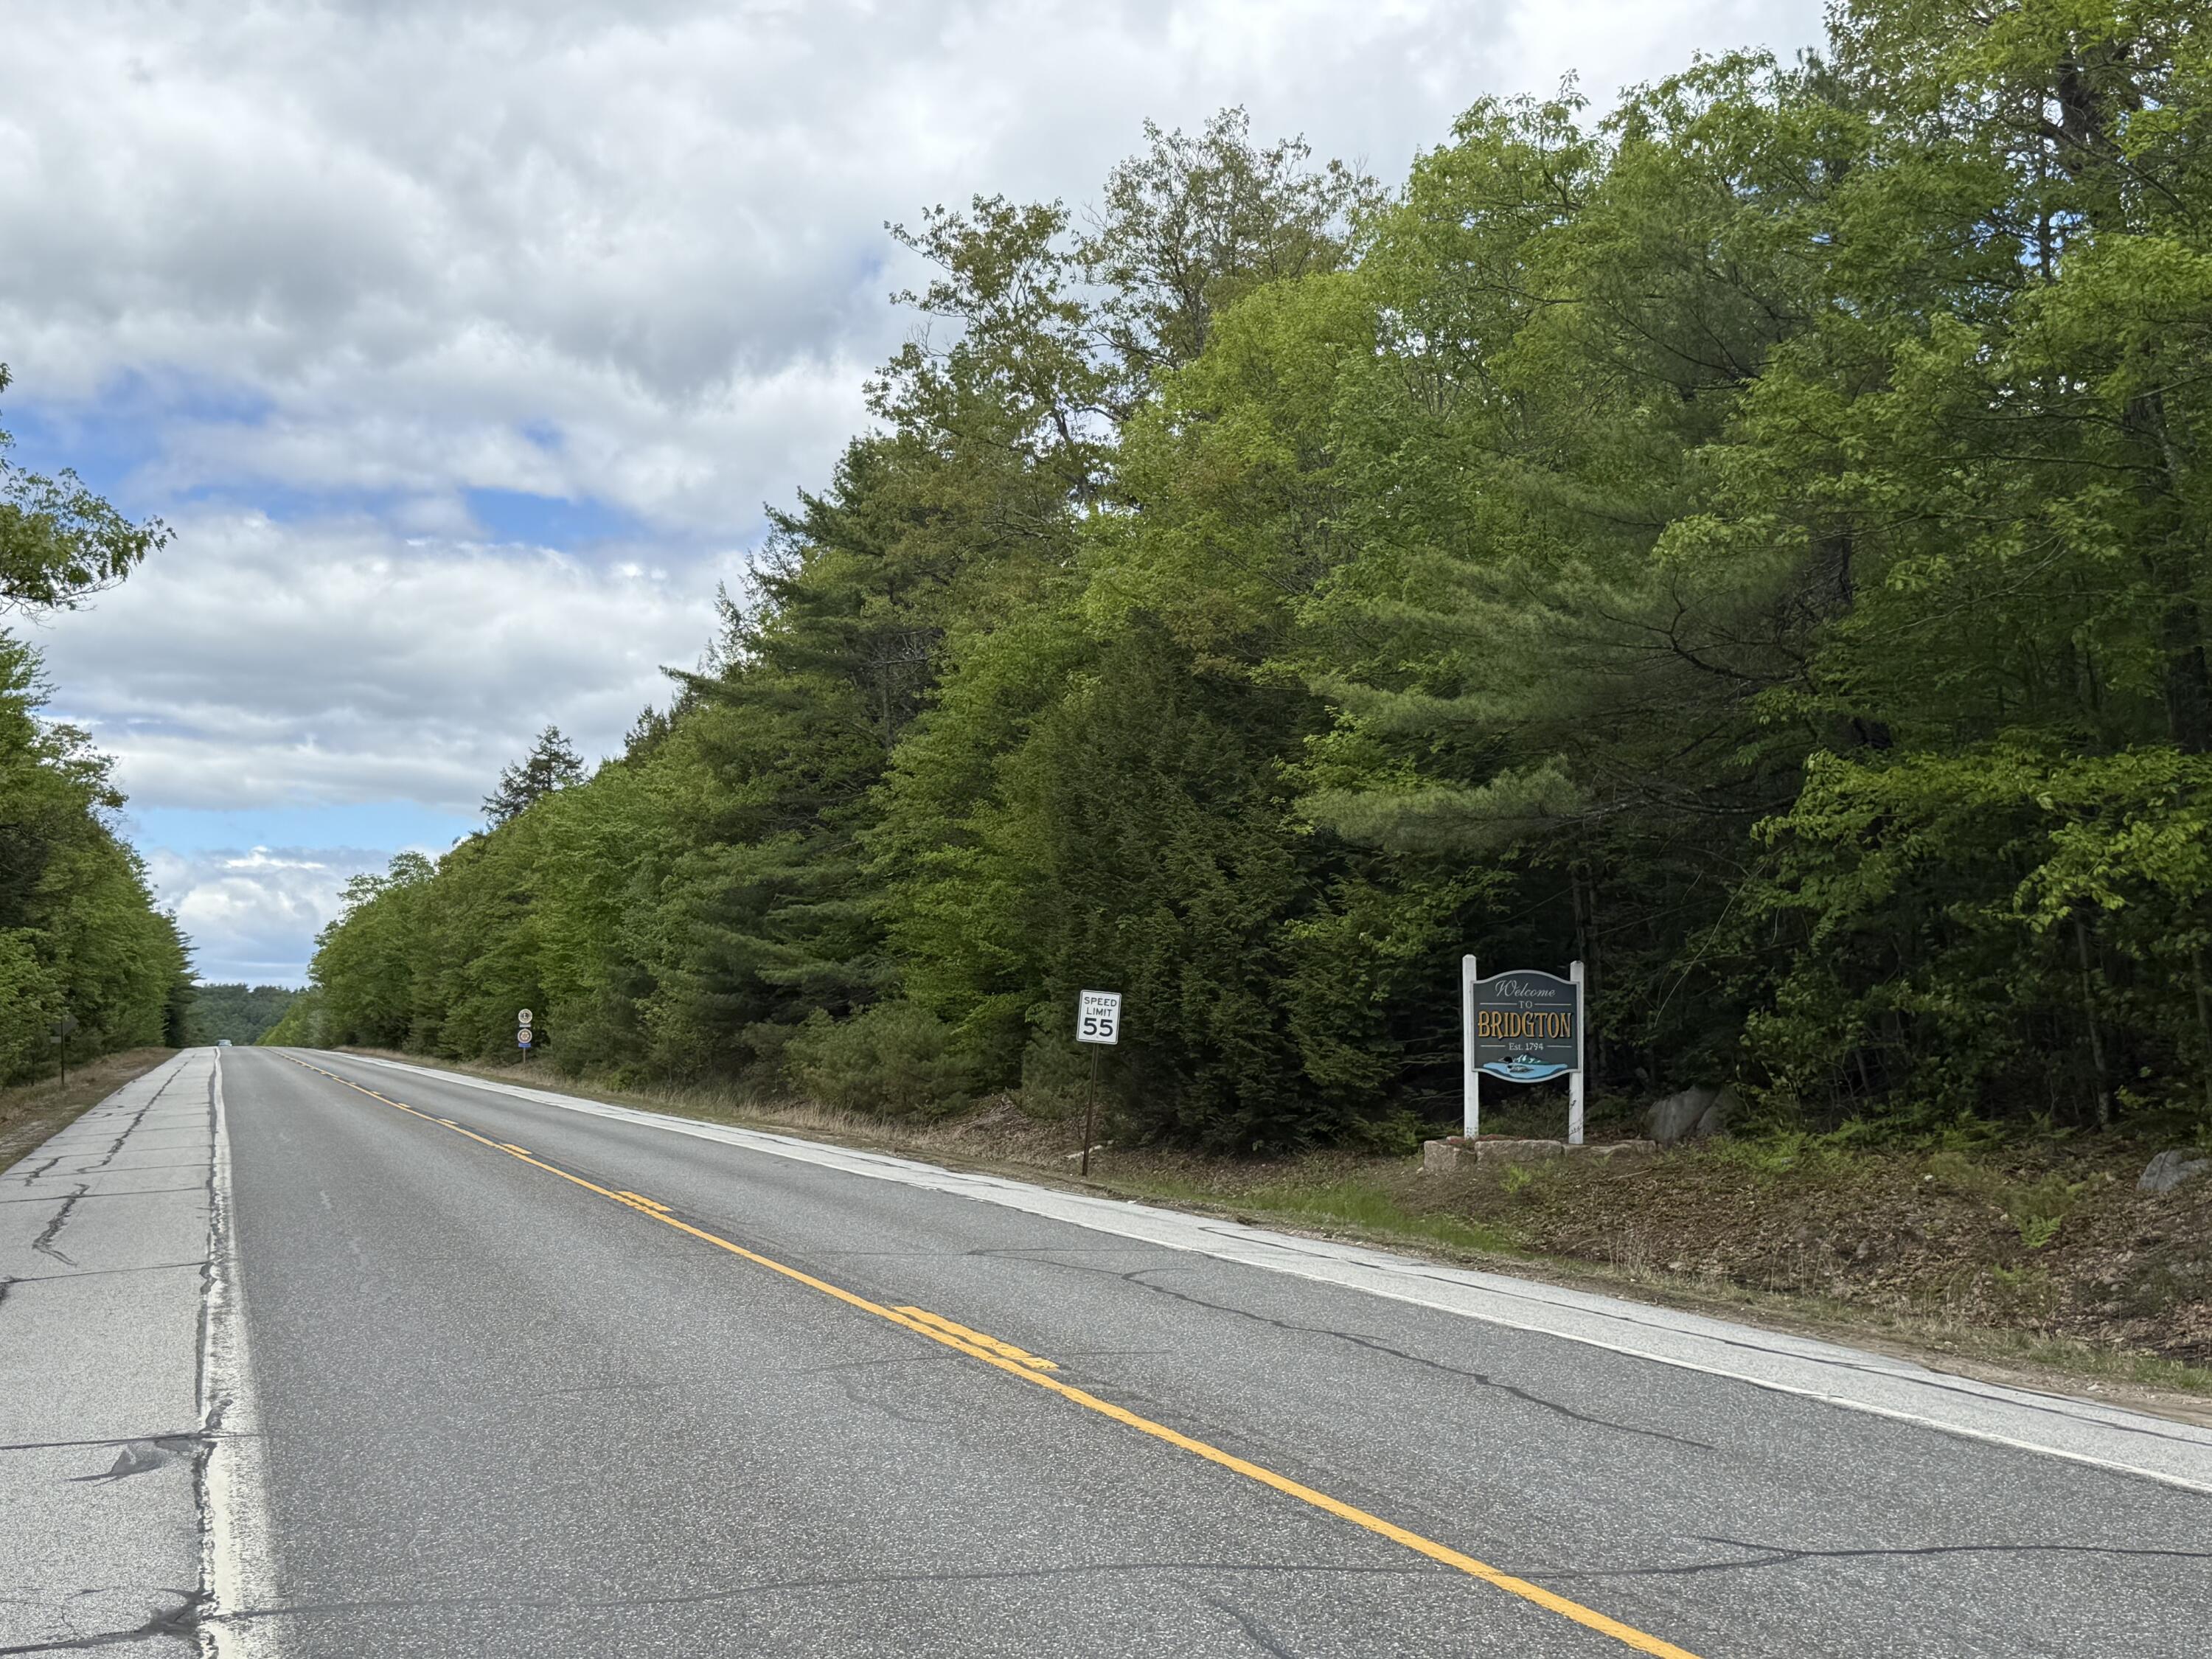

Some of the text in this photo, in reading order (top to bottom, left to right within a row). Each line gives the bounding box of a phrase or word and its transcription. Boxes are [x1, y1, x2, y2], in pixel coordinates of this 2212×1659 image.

[1495, 980, 1556, 998] Welcome
[1084, 996, 1117, 1007] SPEED
[1518, 1001, 1533, 1009] TO
[1086, 1006, 1113, 1017] LIMIT
[1083, 1017, 1113, 1037] 55
[1478, 1011, 1572, 1040] BRIDGTON
[1509, 1043, 1544, 1051] Est. 1794
